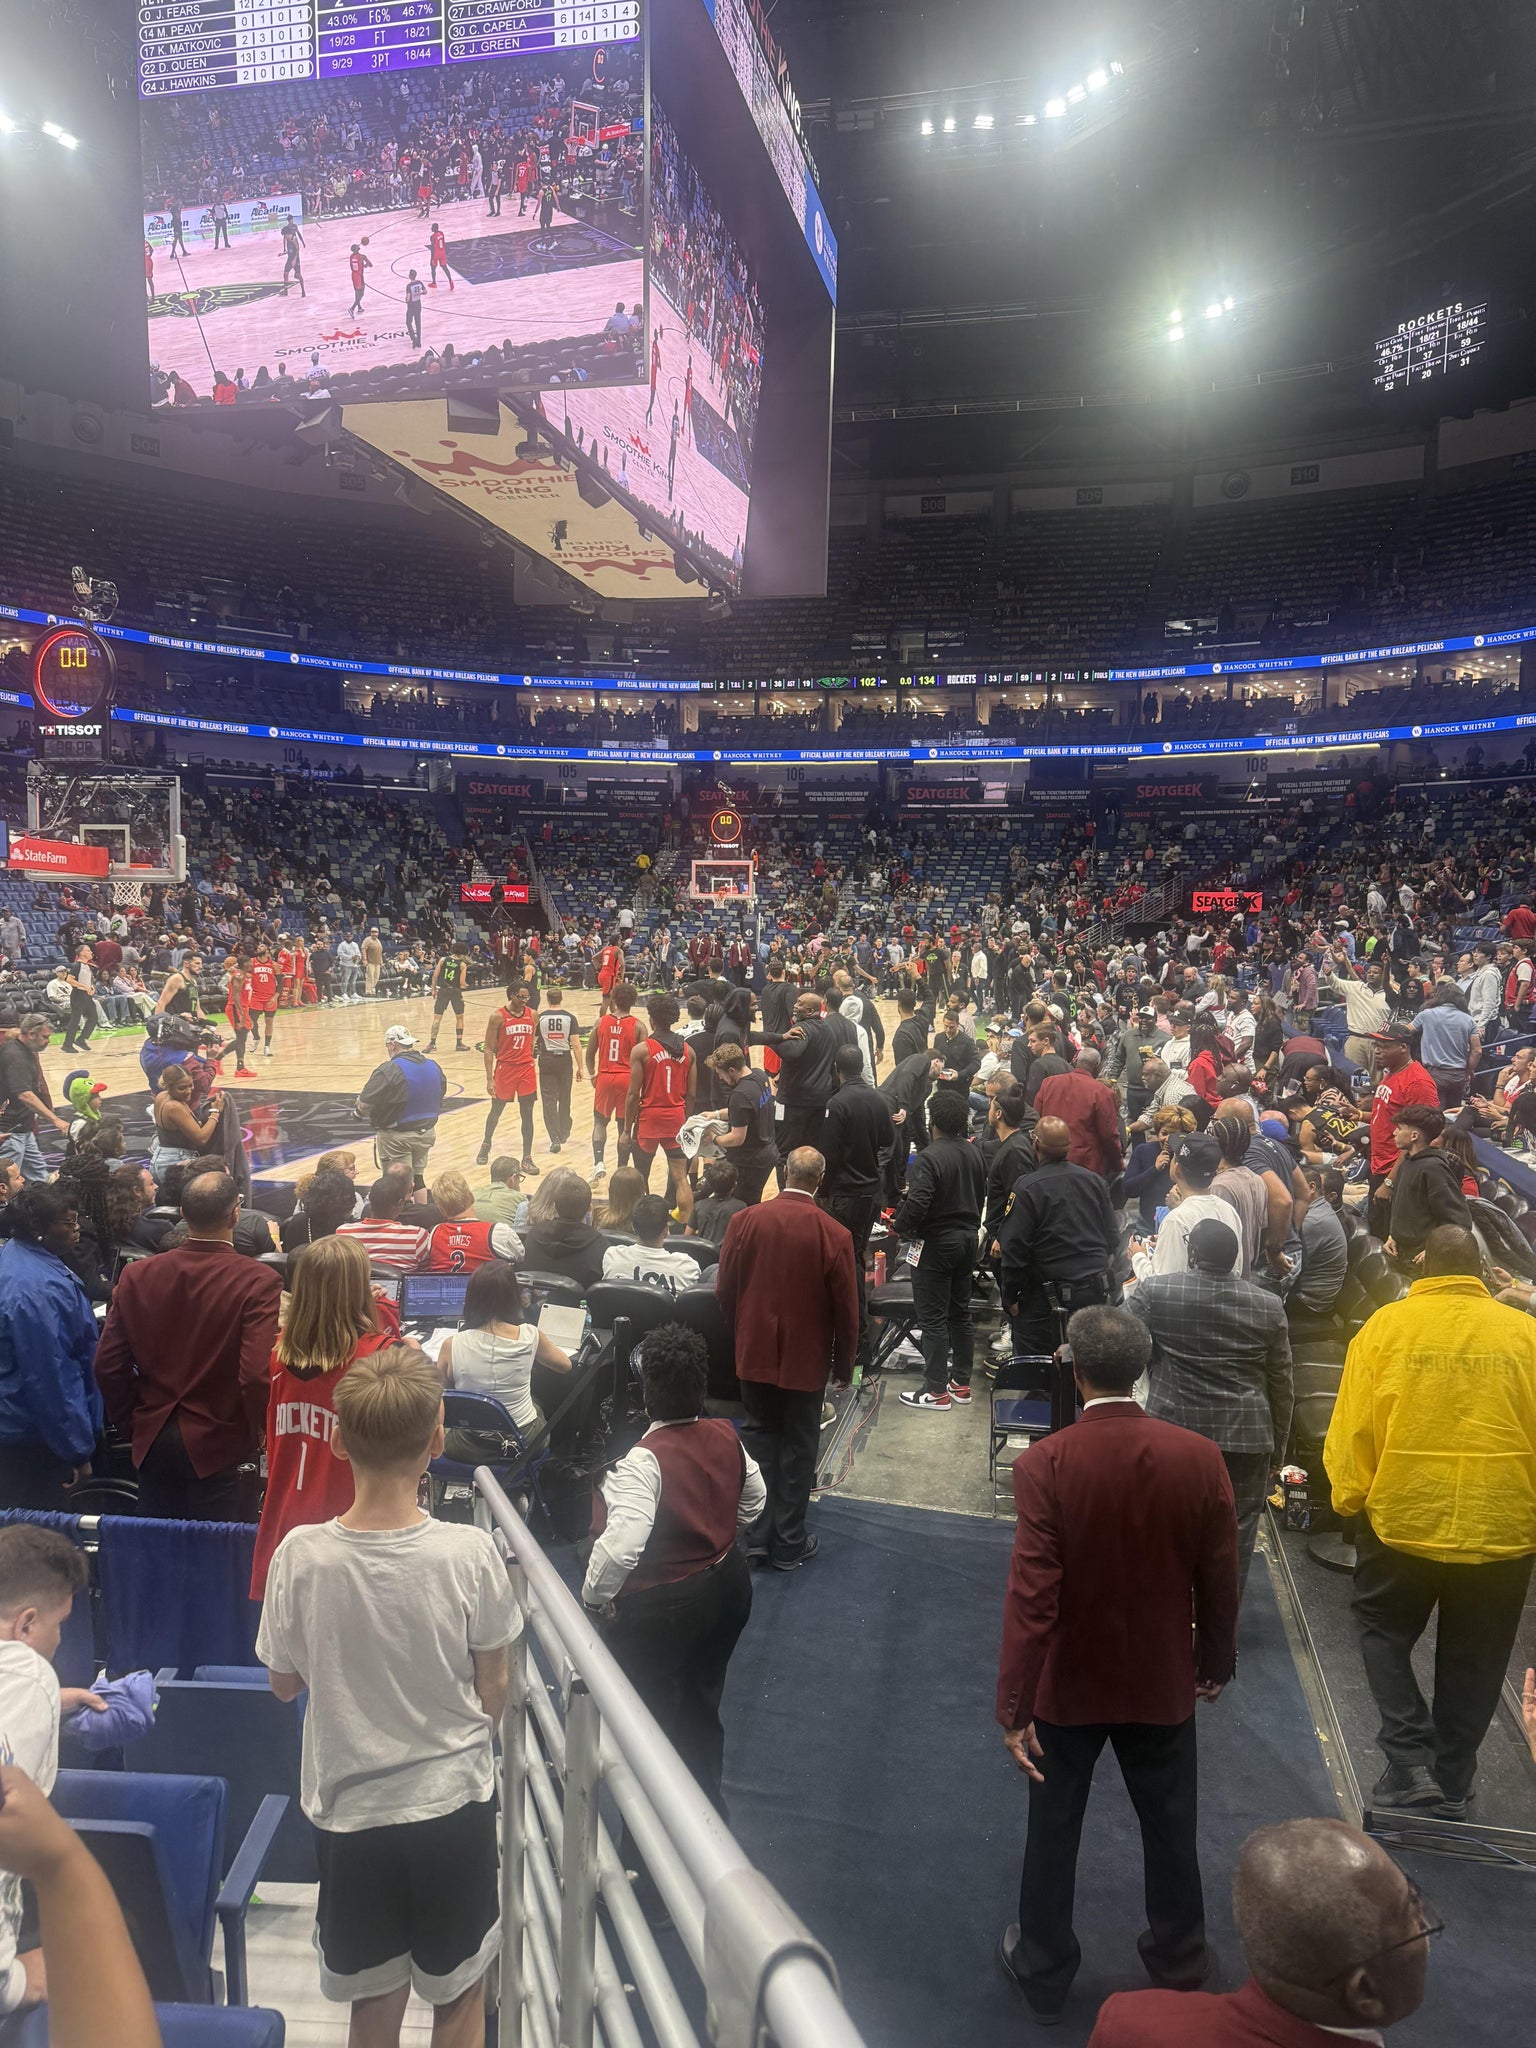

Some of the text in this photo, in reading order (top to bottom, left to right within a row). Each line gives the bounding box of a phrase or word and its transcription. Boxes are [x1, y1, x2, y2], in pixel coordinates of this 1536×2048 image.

[144, 4, 200, 21] 0 J. FEARS
[327, 3, 434, 27] 43.0% FG% 46.7%
[452, 0, 542, 19] 27 I. CRAWFORD
[452, 6, 629, 37] 30 C. CAPELA 6 14 3 4
[143, 22, 204, 39] 14 M. PEAVY
[329, 26, 430, 48] 19/28 FT 18/21
[144, 38, 222, 57] 17 K. MATKOVIC
[452, 45, 466, 56] 32
[470, 43, 478, 54] J.
[480, 38, 520, 52] GREEN
[560, 33, 567, 43] 2
[581, 30, 588, 40] 0
[622, 25, 630, 35] 0
[144, 64, 156, 75] 22
[158, 62, 169, 73] D.
[171, 57, 208, 71] QUEEN
[240, 52, 252, 63] 13
[260, 50, 267, 61] 3
[332, 48, 432, 70] 9/29 3PT 18/44
[145, 64, 304, 93] 24 J. HAWKINS 2 0 0 0
[1398, 302, 1463, 334] ROCKETS
[1456, 316, 1479, 331] 18/44
[1420, 330, 1440, 344] 18/21
[1460, 337, 1471, 348] 59
[1422, 350, 1433, 360] 37
[1460, 356, 1470, 367] 31
[1384, 364, 1394, 374] 22
[1421, 369, 1432, 380] 20
[1384, 381, 1394, 392] 52
[438, 474, 577, 488] SMOOTHIE
[92, 625, 124, 637] WHITNEY
[1486, 633, 1521, 644] HANCOCK
[148, 634, 170, 646] OFFICIAL
[171, 639, 184, 648] BANK
[193, 642, 203, 650] THE
[204, 644, 216, 652] NEW
[216, 645, 240, 655] ORLEANS
[240, 648, 265, 658] PELICANS
[1320, 654, 1344, 664] OFFICIAL
[1344, 652, 1359, 662] BANK
[1368, 649, 1378, 658] THE
[1378, 647, 1391, 657] NEW
[1392, 644, 1416, 656] ORLEANS
[1417, 642, 1444, 652] PELICANS
[60, 647, 87, 668] 0.0
[1224, 660, 1293, 671] HANCOCK WHITNEY
[860, 677, 876, 687] 102
[899, 677, 912, 686] 0.0
[918, 675, 935, 685] 134
[946, 674, 976, 685] ROCKETS
[988, 674, 998, 682] 33
[1020, 674, 1030, 682] 59
[1050, 673, 1057, 681] 2
[56, 724, 102, 736] TISSOT
[1424, 721, 1496, 734] HANCOCK WHITNEY
[1023, 747, 1046, 756] OFFICIAL
[1047, 747, 1061, 755] BANK
[1069, 746, 1080, 755] THE
[1080, 746, 1093, 754] NEW
[1093, 746, 1116, 754] ORLEANS
[1117, 745, 1143, 754] PELICANS
[557, 764, 577, 779] 105
[1244, 757, 1268, 773] 108
[786, 767, 805, 782] 106
[468, 781, 532, 798] SEATGEEK
[907, 787, 970, 800] SEATGEEK
[1136, 782, 1203, 799] SEATGEEK
[443, 968, 455, 980] 14
[505, 1024, 533, 1036] ROCKETS
[548, 1018, 562, 1032] 86
[610, 1025, 623, 1035] TATE
[512, 1036, 526, 1050] 27
[609, 1038, 620, 1062] 8
[665, 1065, 672, 1094] 1
[448, 1234, 472, 1247] JONES
[296, 1440, 308, 1491] 1
